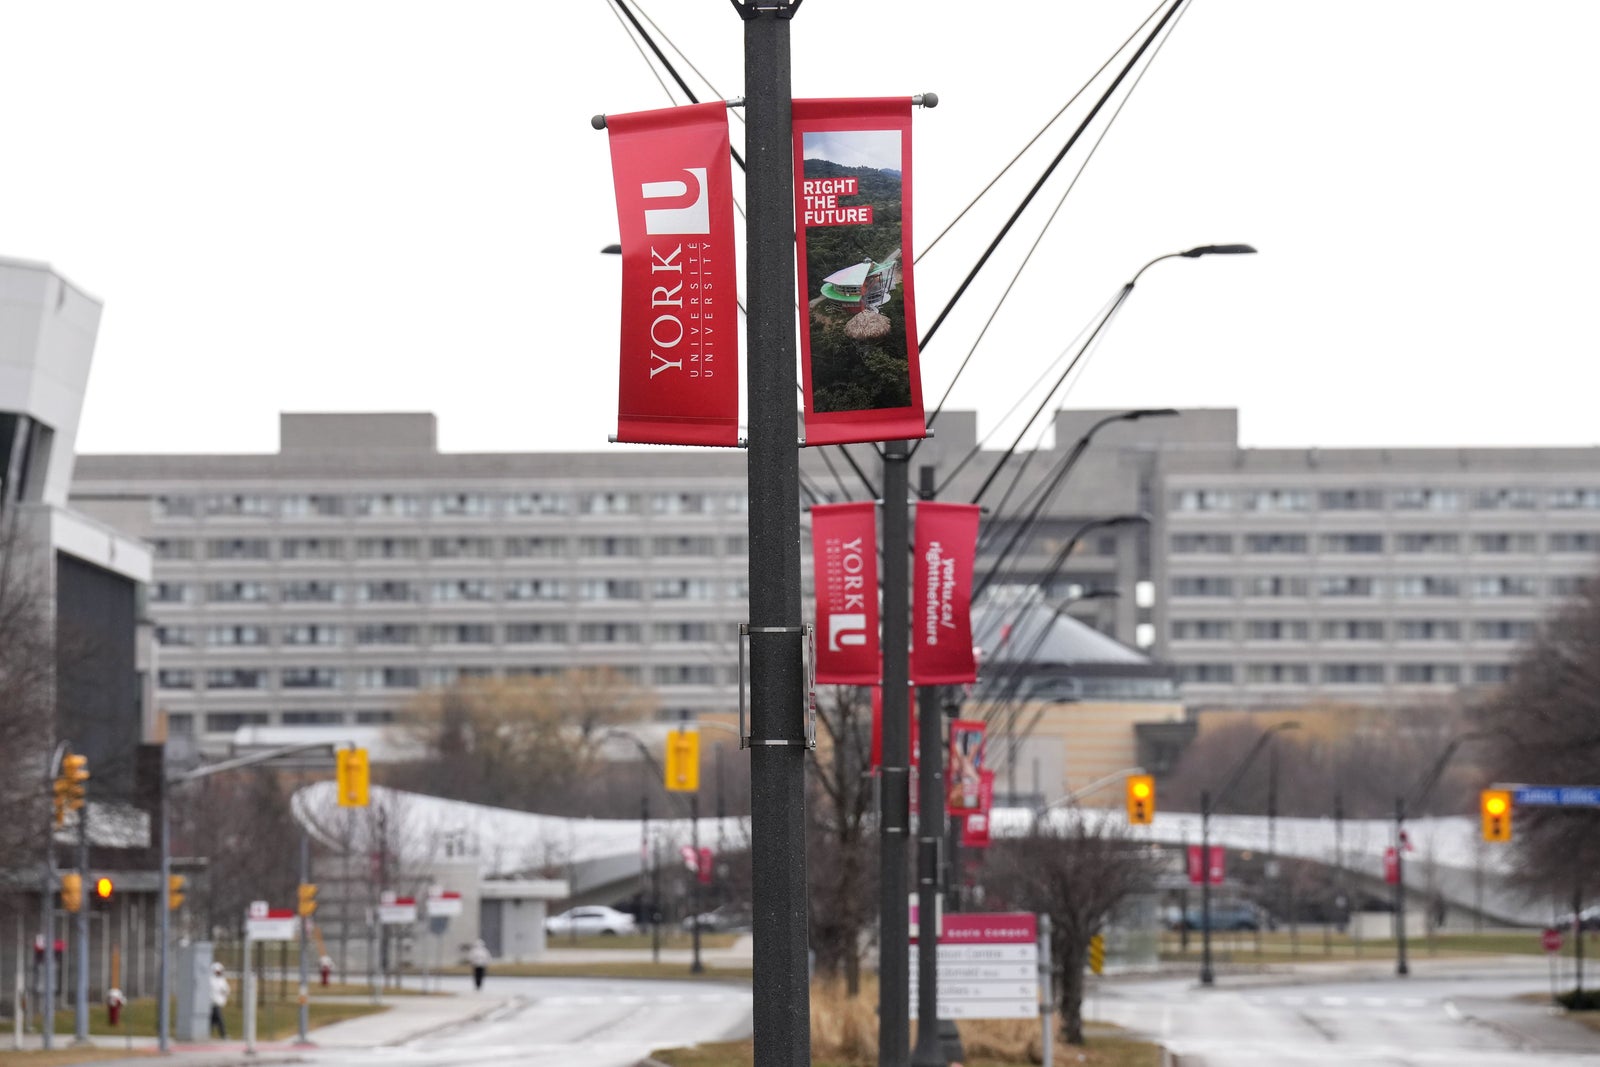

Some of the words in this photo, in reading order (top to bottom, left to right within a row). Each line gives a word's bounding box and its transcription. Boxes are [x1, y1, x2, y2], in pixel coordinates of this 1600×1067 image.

[803, 179, 856, 195] RIGHT
[804, 195, 836, 210] THE
[650, 243, 684, 379] YORK
[688, 242, 700, 378] UNIVERSITÉ
[702, 242, 714, 378] UNIVERSITY
[842, 537, 865, 610] YORK
[925, 541, 943, 645] rightthefuture
[940, 557, 956, 629] yorku.ca/
